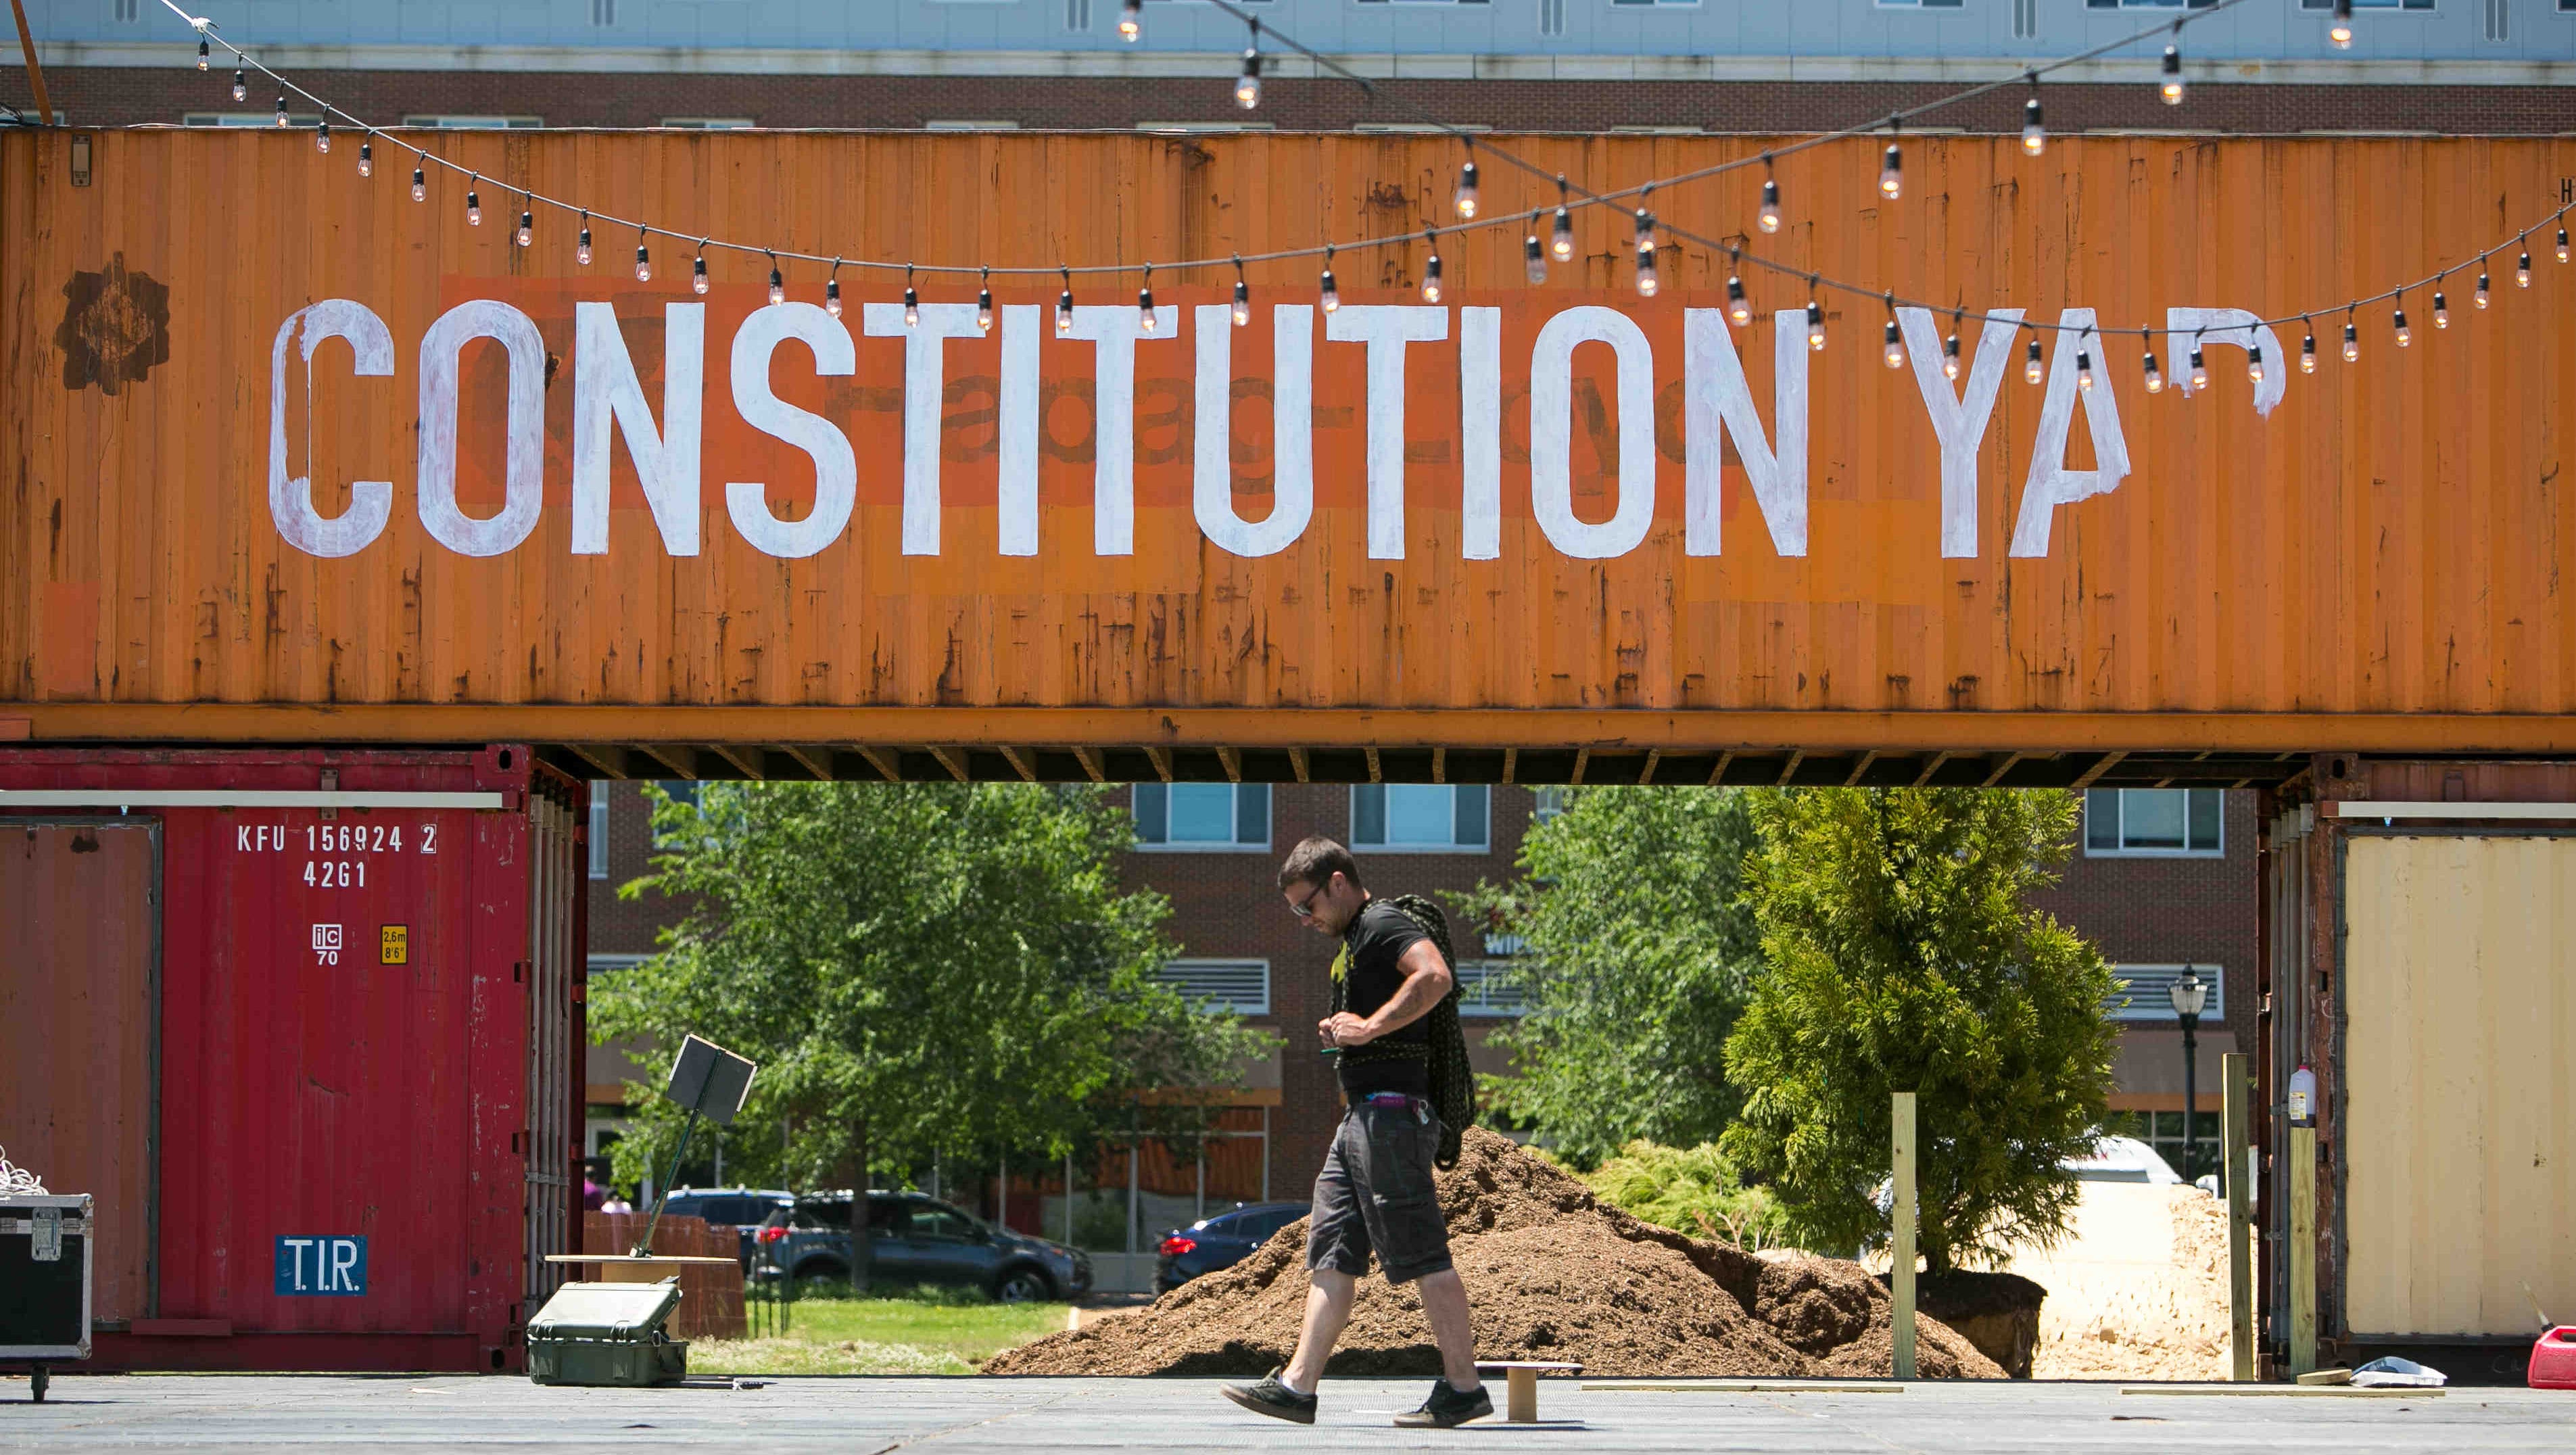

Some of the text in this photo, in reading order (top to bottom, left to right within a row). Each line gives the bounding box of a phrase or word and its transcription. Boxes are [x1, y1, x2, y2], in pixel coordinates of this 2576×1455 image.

[268, 298, 1809, 560] CONSTITUTION
[238, 826, 435, 853] KFU 156924 2
[304, 861, 365, 887] 42G1
[316, 951, 339, 965] 70
[284, 1239, 360, 1291] T.I.R.
